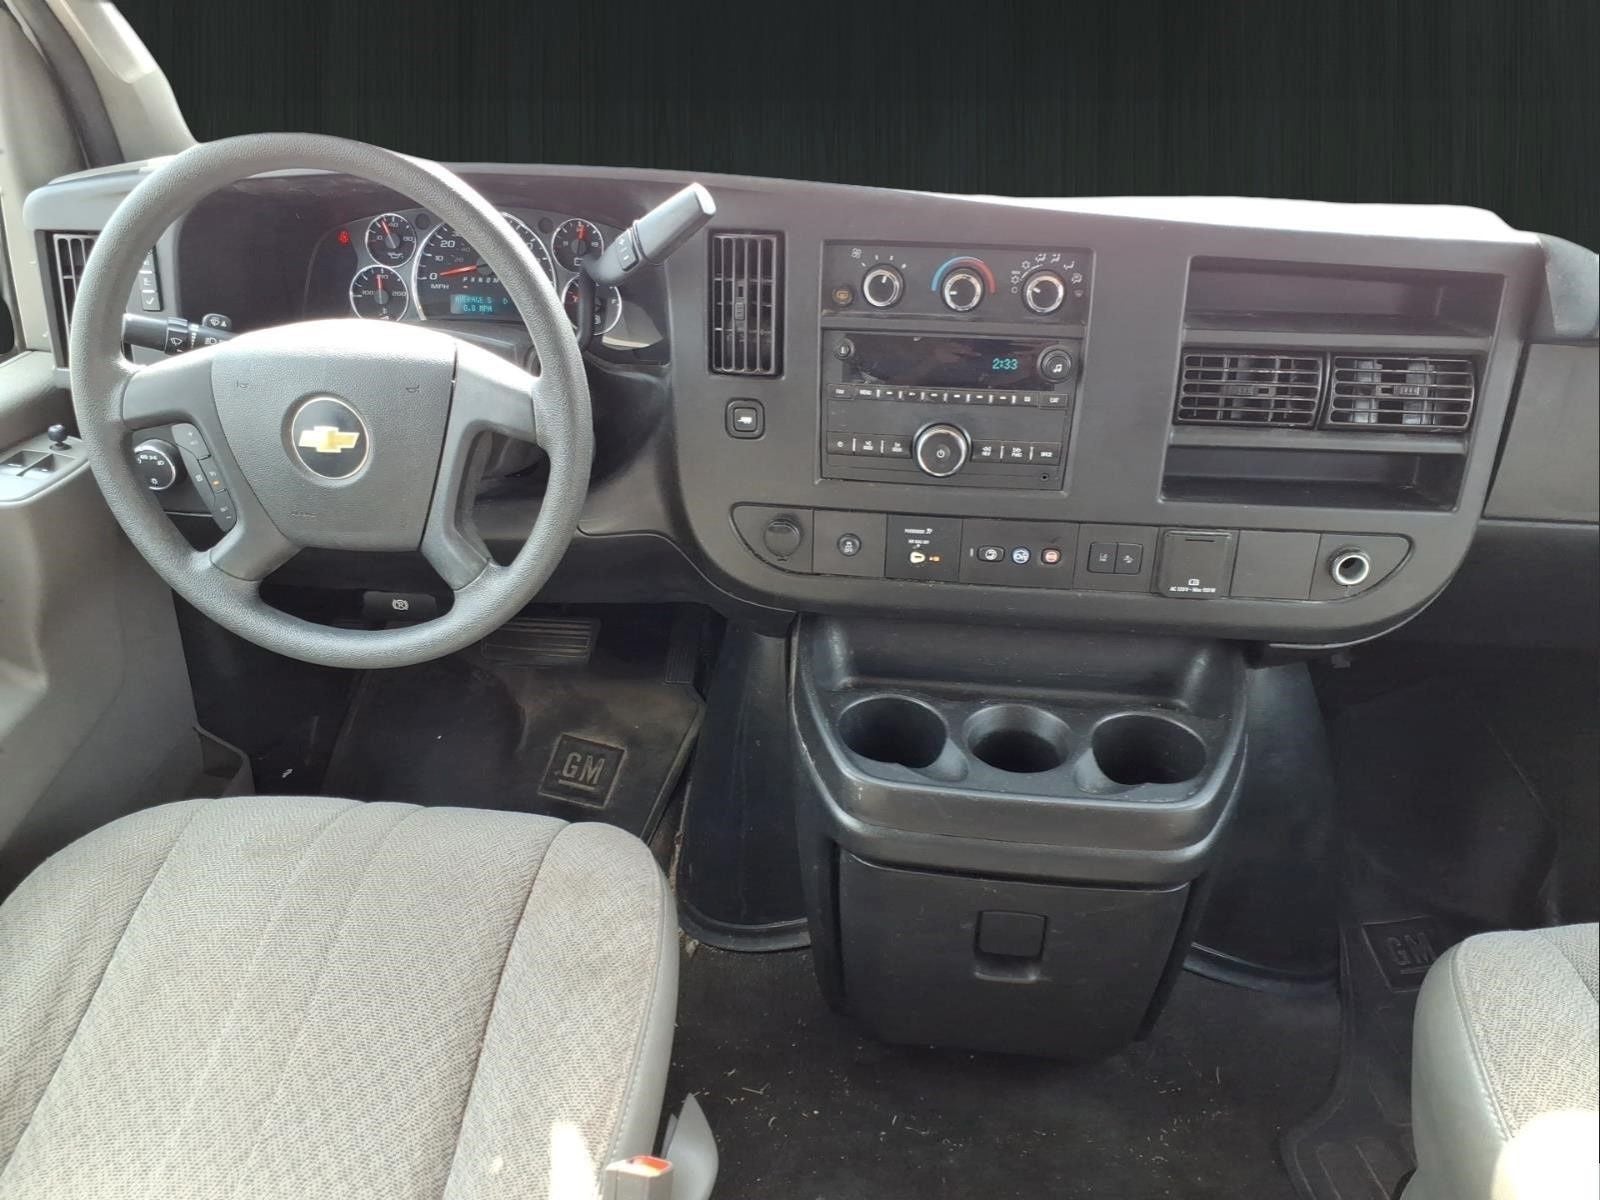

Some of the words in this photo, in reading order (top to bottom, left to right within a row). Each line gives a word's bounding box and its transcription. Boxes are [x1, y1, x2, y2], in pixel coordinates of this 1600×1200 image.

[440, 240, 456, 248] 20
[430, 272, 438, 280] 0
[992, 357, 1018, 370] 2:33
[562, 751, 605, 785] GM
[1386, 931, 1437, 966] GM
